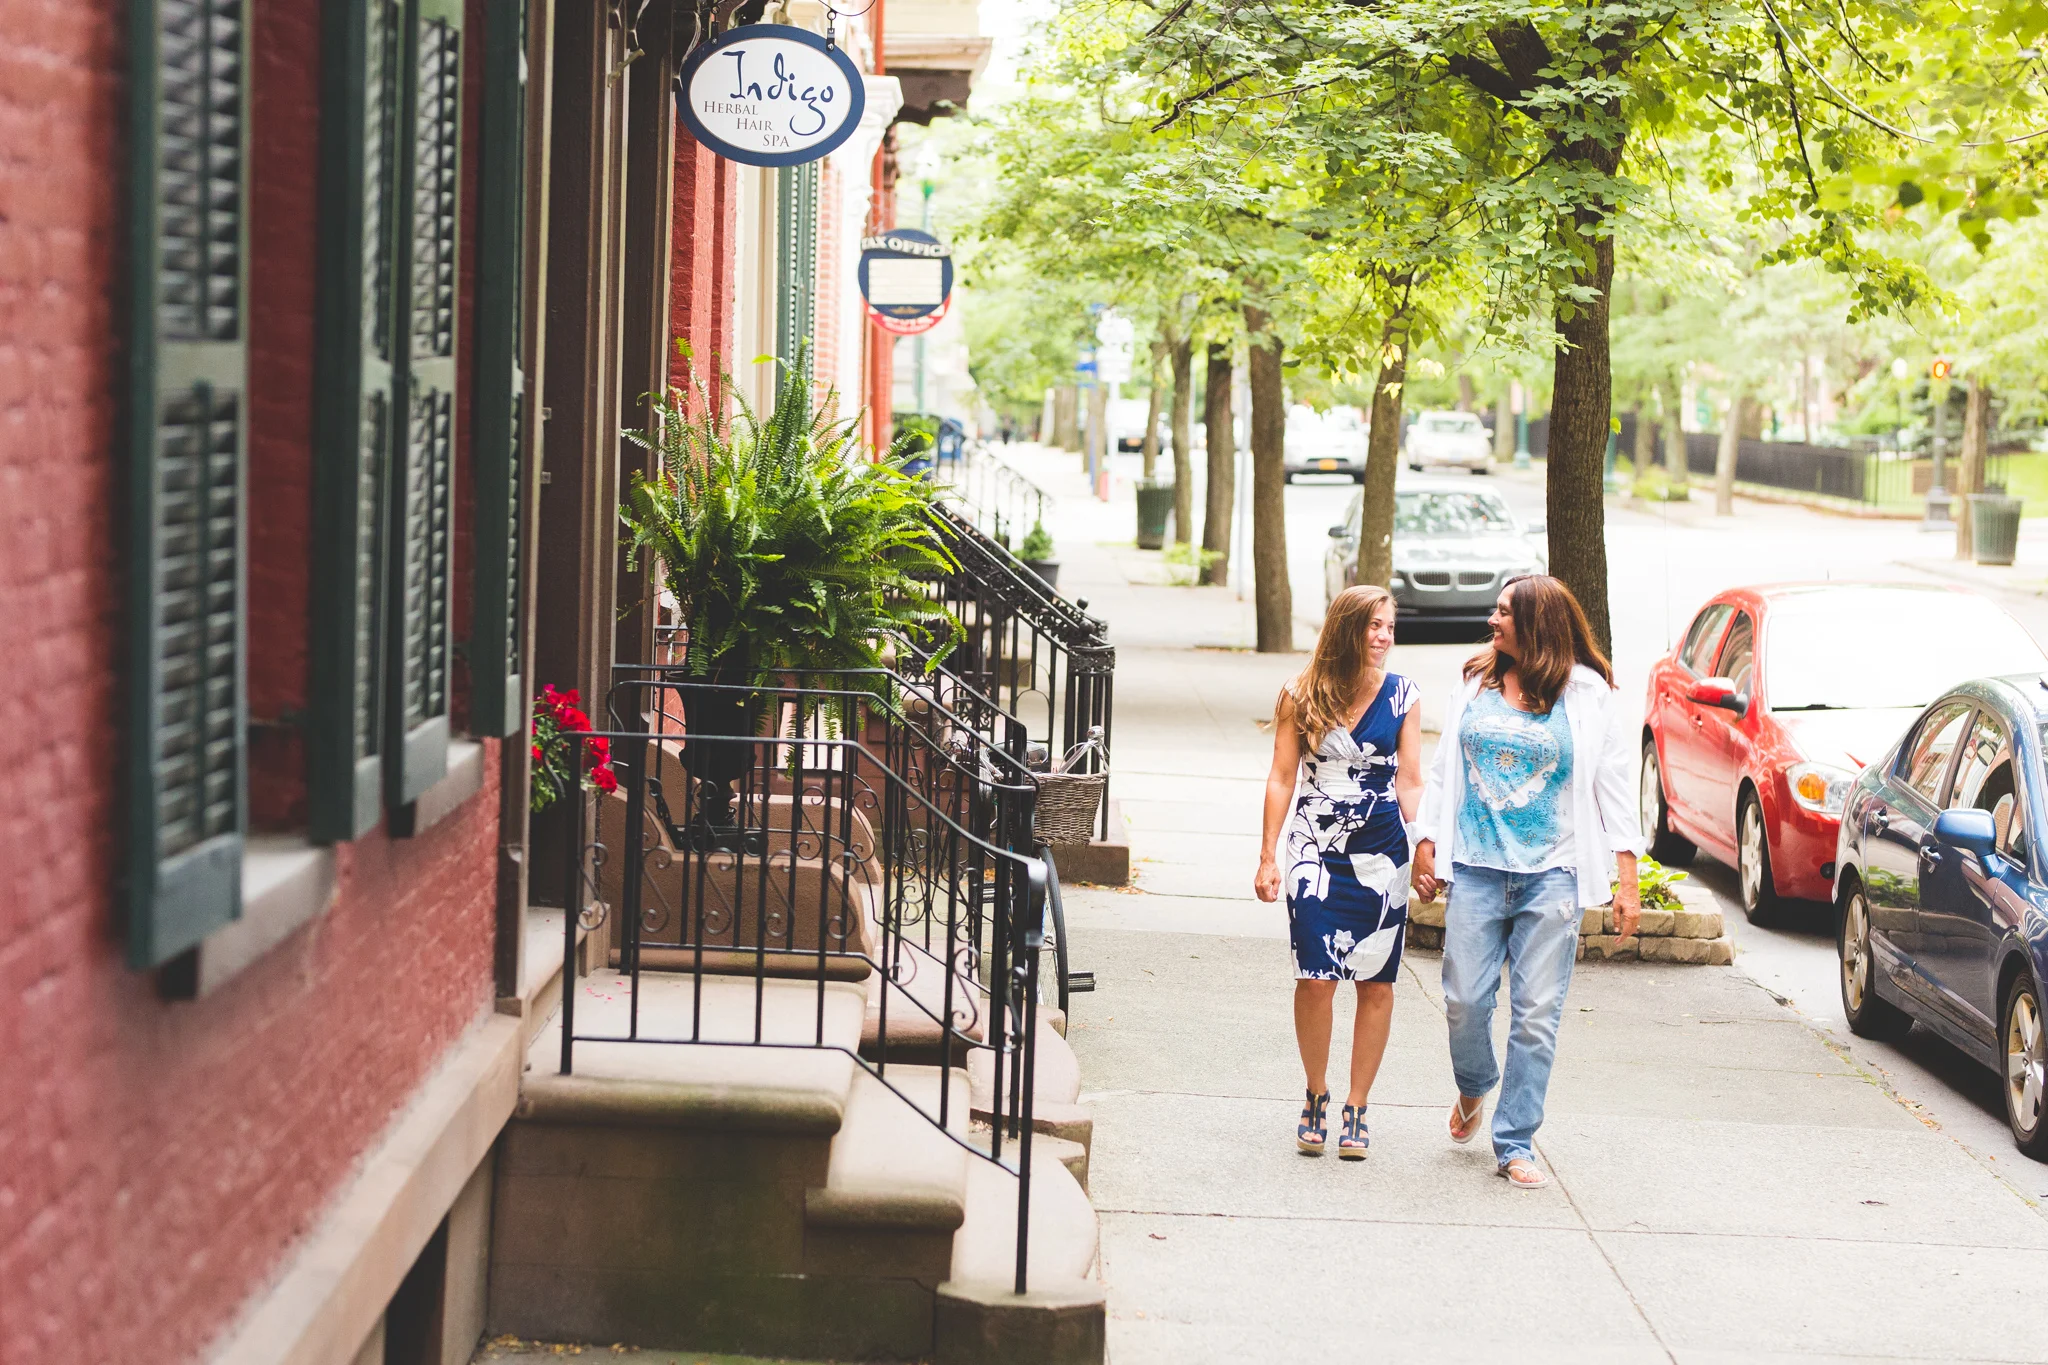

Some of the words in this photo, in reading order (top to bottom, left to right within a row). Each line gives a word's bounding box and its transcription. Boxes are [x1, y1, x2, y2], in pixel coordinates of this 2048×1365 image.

[722, 50, 834, 136] Indigo
[703, 100, 759, 115] HERBAL
[736, 117, 773, 131] HAIR
[762, 134, 790, 147] SPA
[861, 236, 886, 250] TAX
